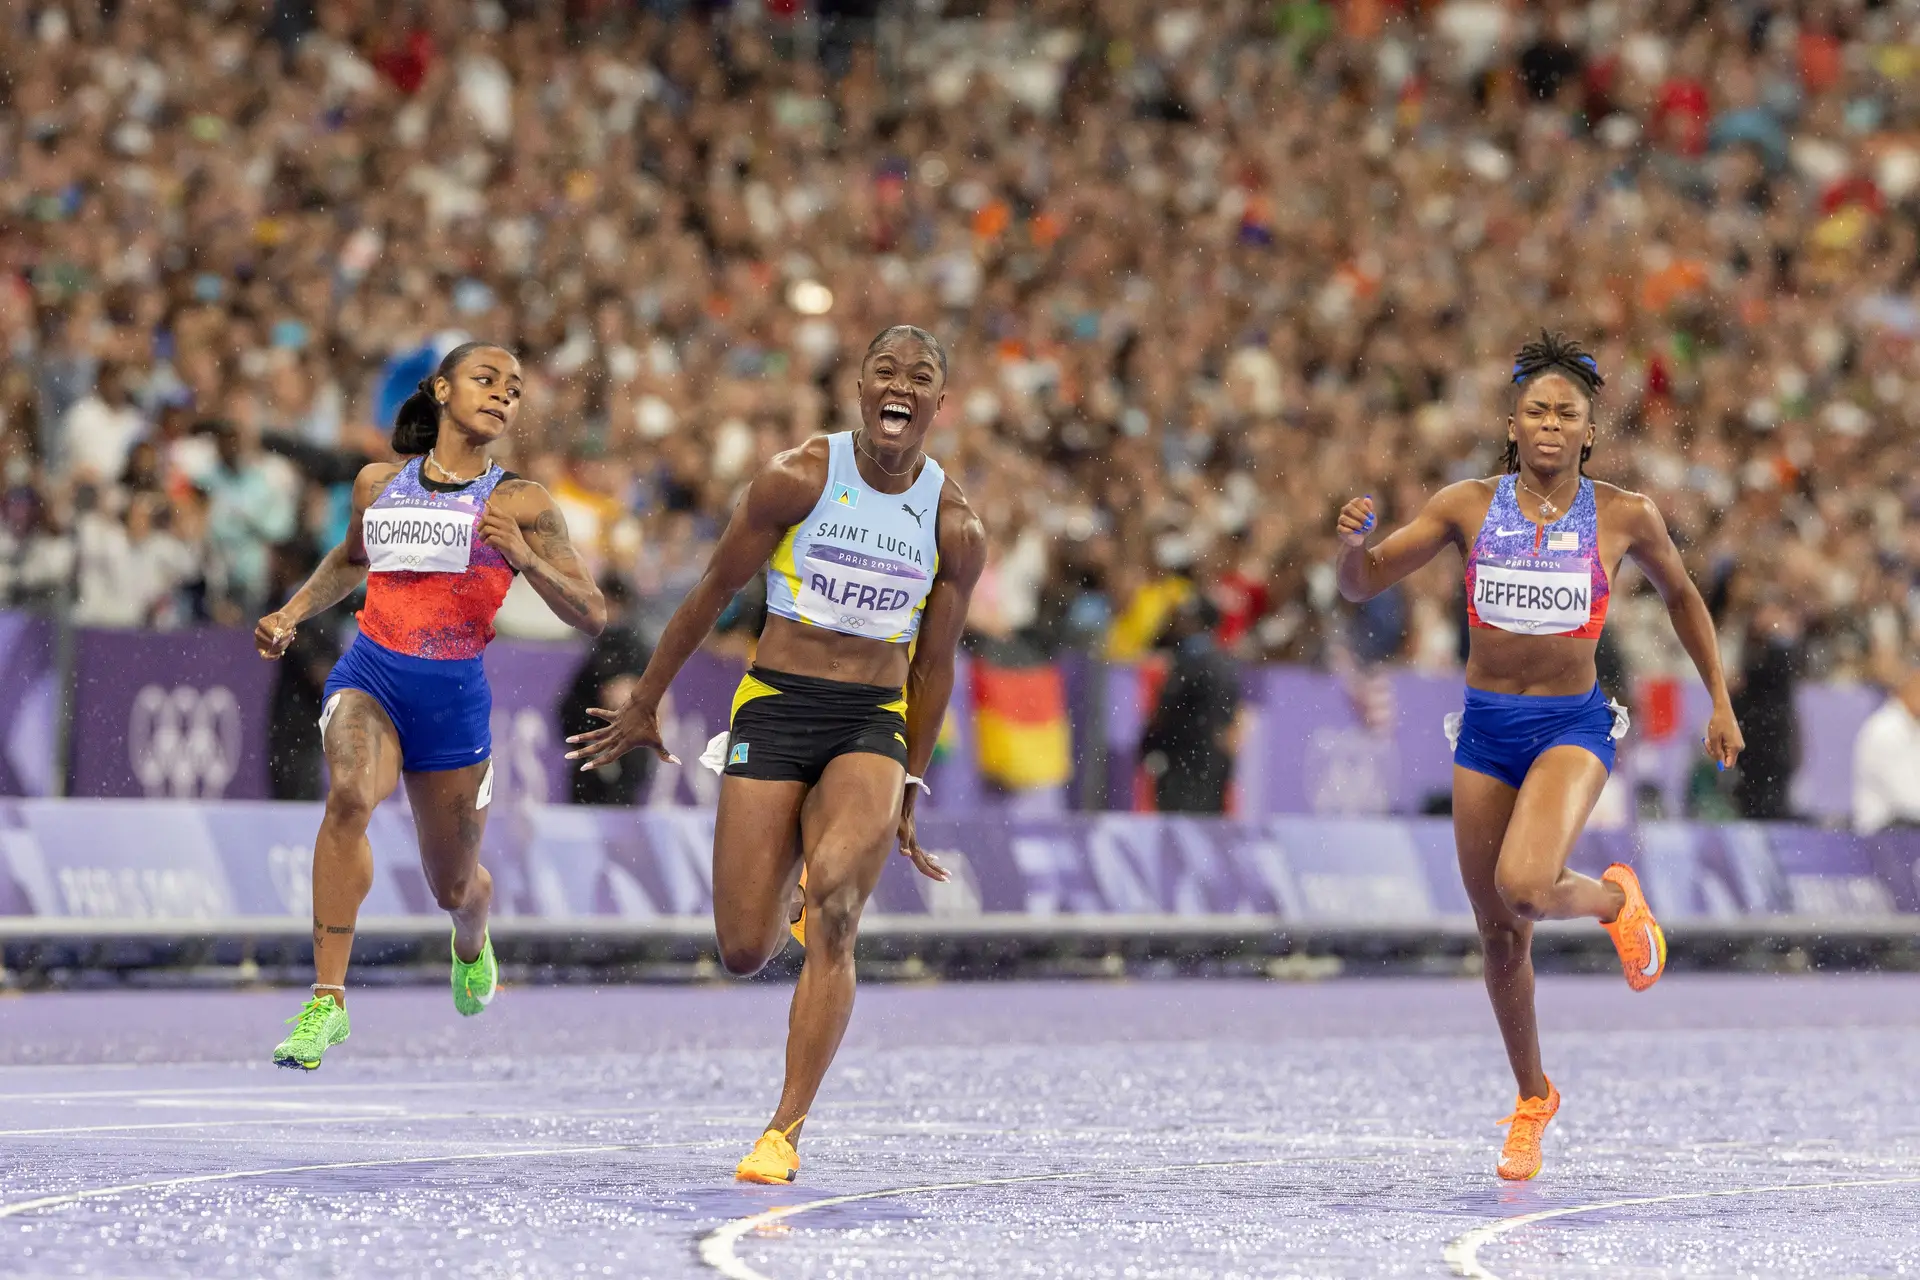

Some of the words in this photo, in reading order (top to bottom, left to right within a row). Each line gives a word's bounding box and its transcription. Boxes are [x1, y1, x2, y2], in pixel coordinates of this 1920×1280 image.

[394, 498, 420, 506] PARIS
[422, 499, 449, 508] 2024
[366, 519, 470, 547] RICHARDSON
[816, 522, 869, 544] SAINT
[877, 533, 923, 565] LUCIA
[838, 552, 868, 566] PARIS
[871, 560, 899, 572] 2024
[1505, 559, 1532, 567] PARIS
[1534, 560, 1561, 569] 2024
[810, 573, 910, 611] ALFRED
[1477, 579, 1587, 611] JEFFERSON
